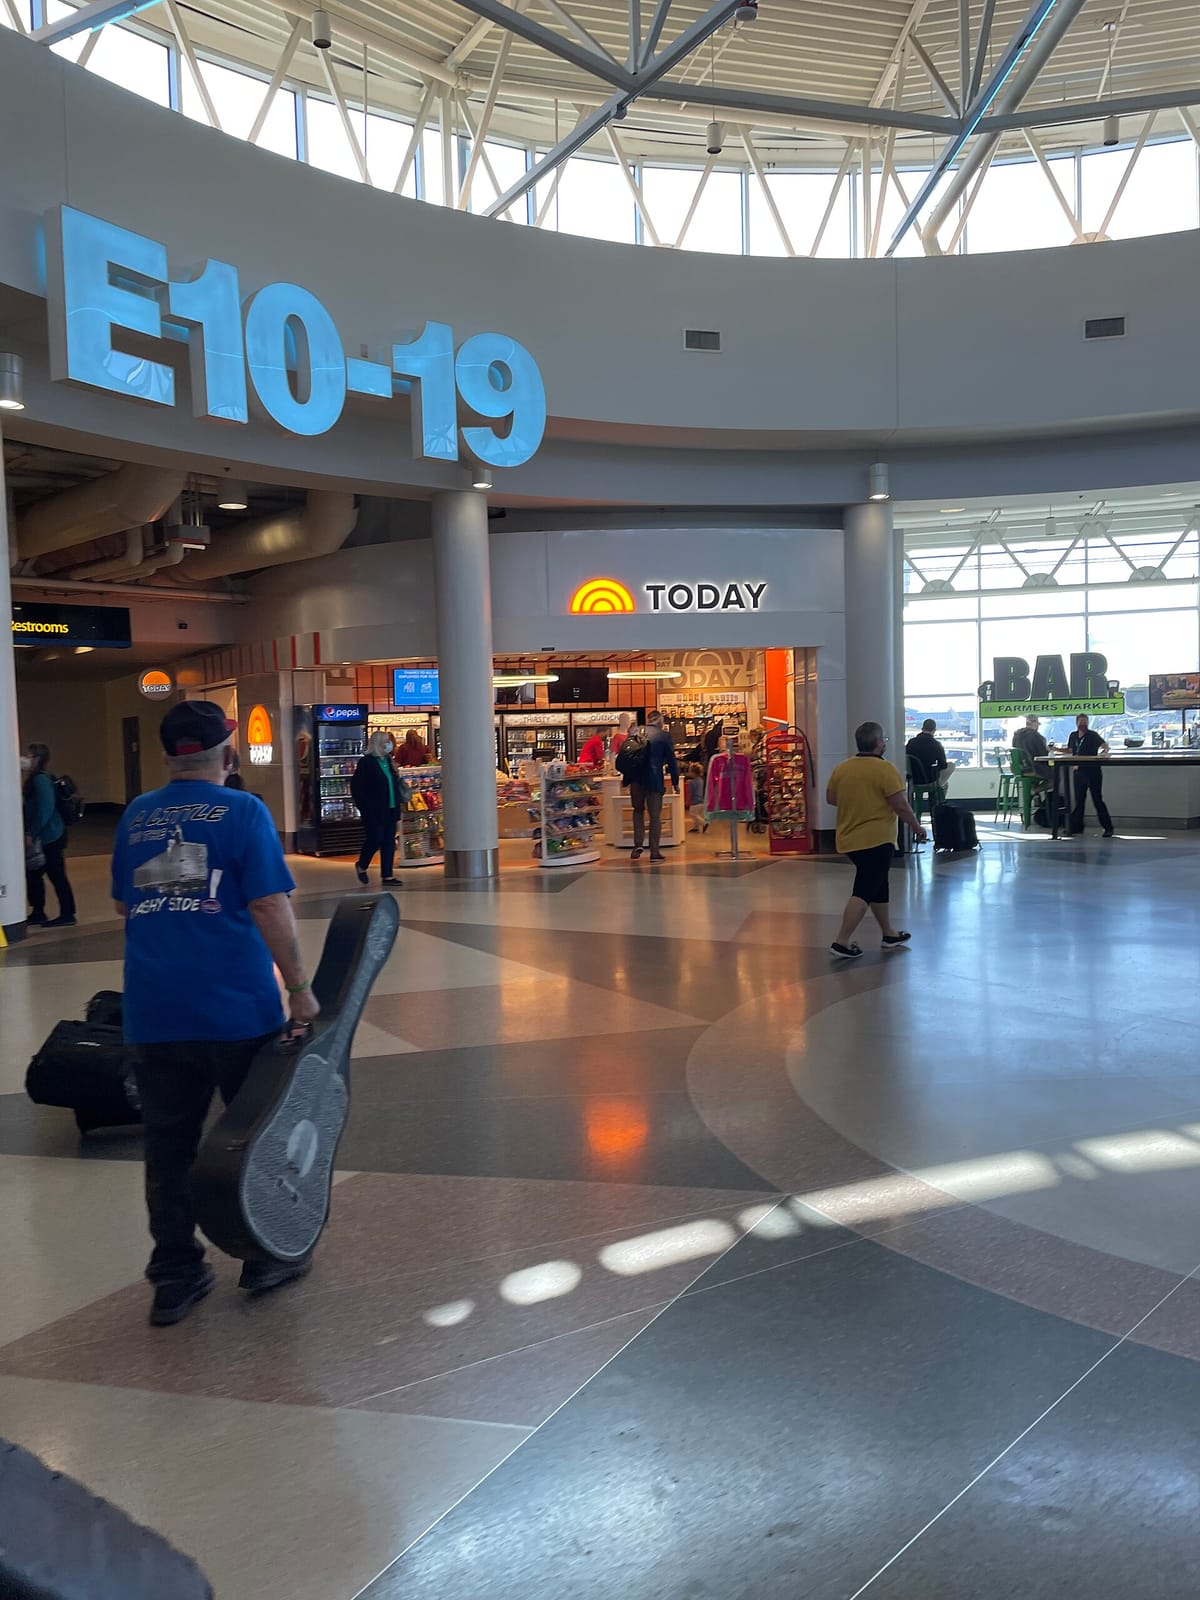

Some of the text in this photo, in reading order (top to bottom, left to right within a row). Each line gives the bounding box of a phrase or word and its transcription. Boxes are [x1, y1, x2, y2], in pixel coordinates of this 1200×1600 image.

[50, 204, 548, 467] E10-19
[646, 583, 767, 610] TODAY
[993, 652, 1108, 701] BAR
[335, 708, 359, 718] pepsi
[998, 703, 1058, 713] FARMERS
[1062, 702, 1119, 711] MARKET
[168, 896, 201, 912] SIDE
